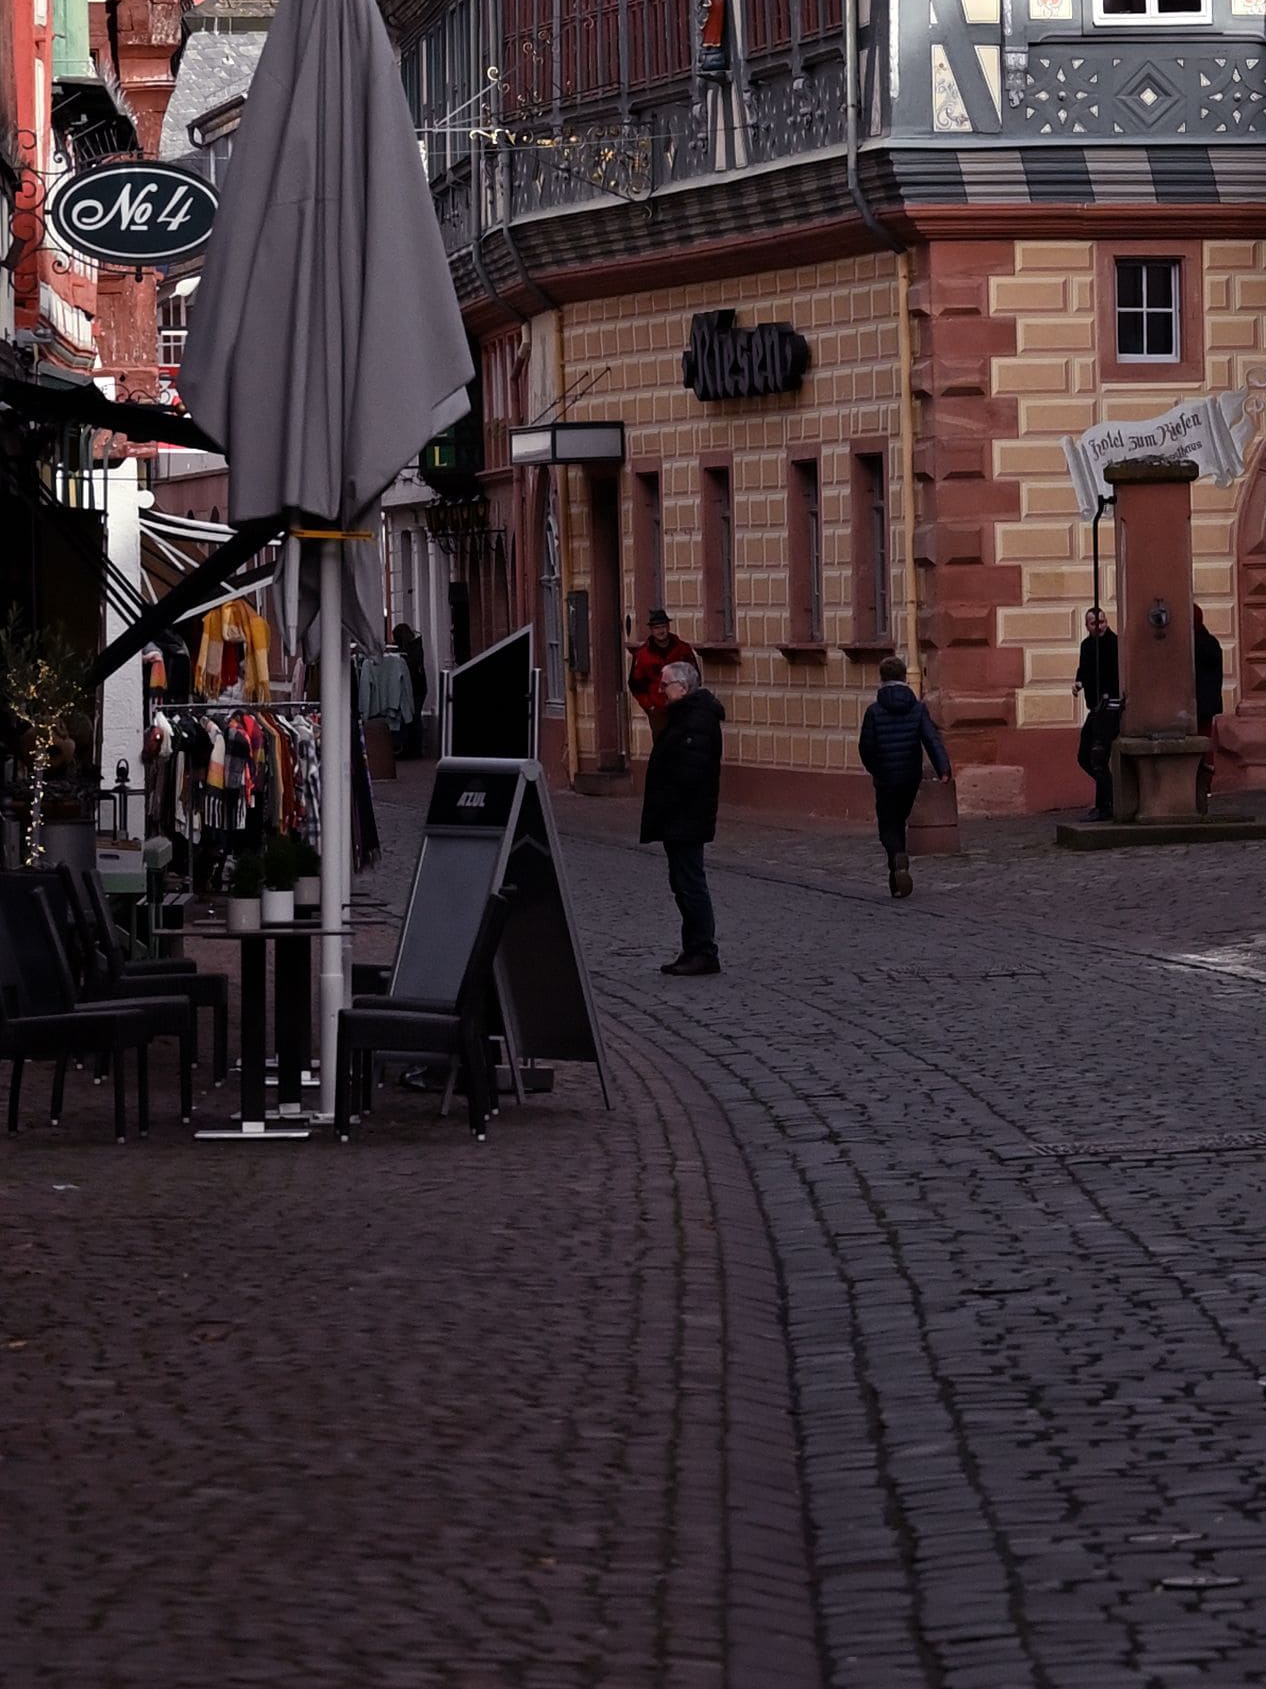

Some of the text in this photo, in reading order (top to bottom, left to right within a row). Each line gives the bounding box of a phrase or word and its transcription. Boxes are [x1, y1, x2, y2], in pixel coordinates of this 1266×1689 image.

[157, 184, 193, 233] 4
[1088, 412, 1203, 462] Hotel zum Riesen
[456, 791, 487, 808] AZUL
